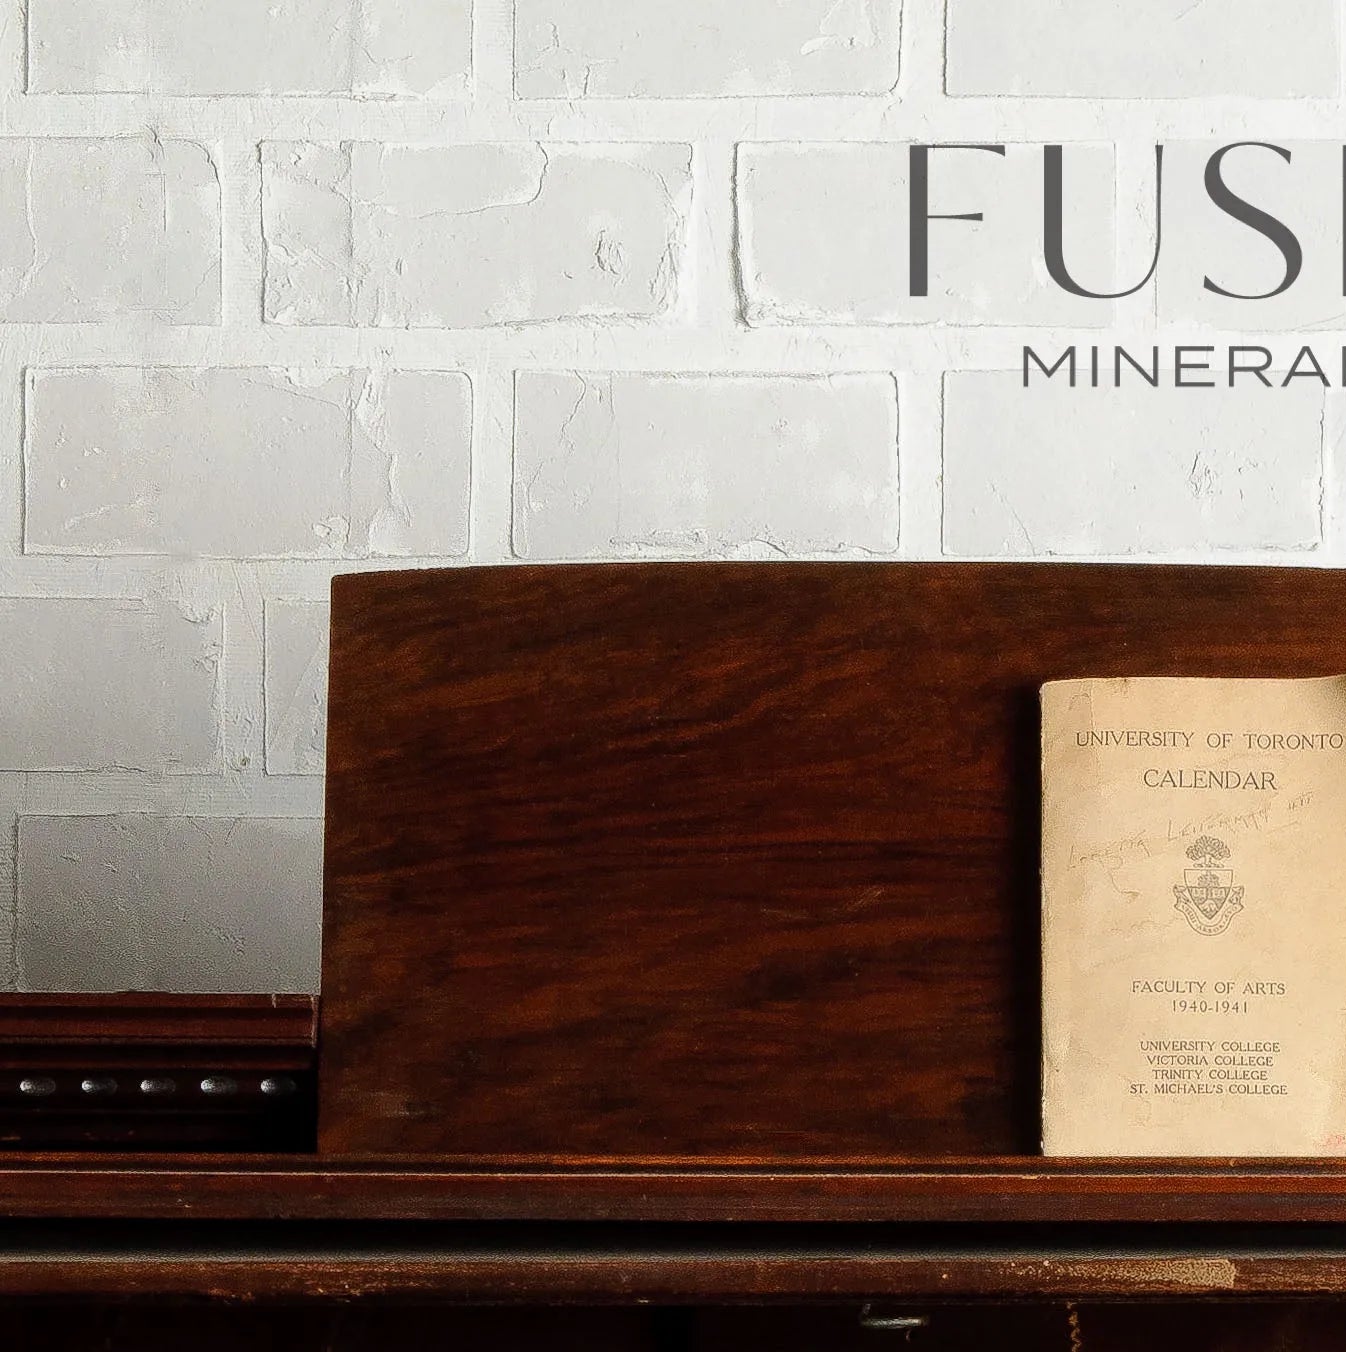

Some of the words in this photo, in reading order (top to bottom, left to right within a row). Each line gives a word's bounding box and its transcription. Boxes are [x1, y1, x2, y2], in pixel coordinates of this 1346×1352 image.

[1076, 731, 1195, 747] UNIVERSITY
[1206, 733, 1233, 748] OF
[1243, 732, 1344, 750] TORONTO
[1143, 769, 1277, 790] CALENDAR
[1132, 980, 1207, 993] FACULTY
[1214, 981, 1235, 994] OF
[1242, 982, 1286, 995] ARTS
[1172, 999, 1247, 1013] 1940-1941
[1140, 1040, 1215, 1051] UNIVERSITY
[1221, 1041, 1281, 1052] COLLEGE
[1146, 1055, 1209, 1066] VICTORIA
[1214, 1055, 1274, 1067] COLLEGE
[1152, 1069, 1203, 1080] TRINITY
[1208, 1069, 1268, 1081] COLLEGE
[1129, 1083, 1149, 1095] ST.
[1154, 1083, 1223, 1095] MICHAEL'S
[1228, 1084, 1288, 1096] COLLEGE
